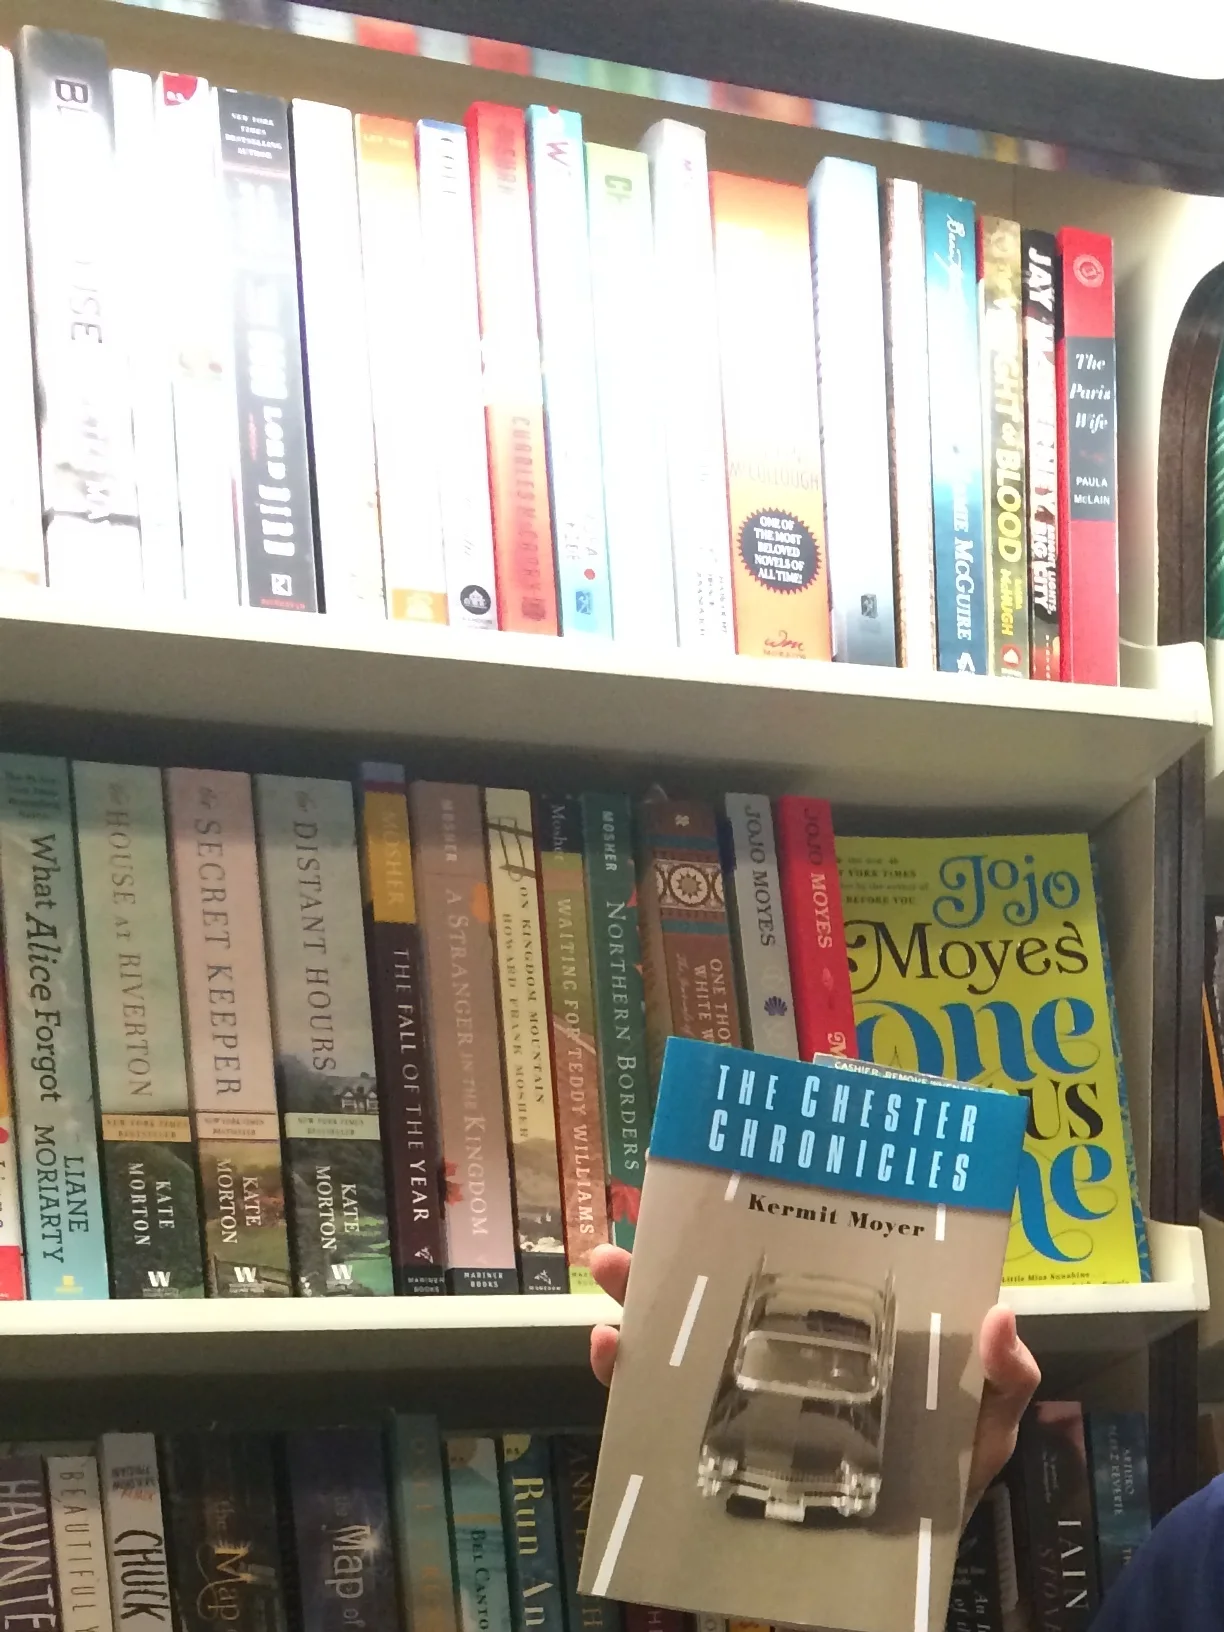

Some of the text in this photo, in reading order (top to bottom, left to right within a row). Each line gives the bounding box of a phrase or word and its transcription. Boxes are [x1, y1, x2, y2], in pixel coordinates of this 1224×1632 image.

[1069, 383, 1111, 401] Paris
[1075, 353, 1106, 371] The
[1075, 412, 1109, 433] Wife
[1076, 477, 1108, 487] PAULA
[754, 527, 802, 545] THE MOST
[756, 543, 801, 558] BELOVED
[759, 516, 795, 530] ONE OF
[754, 554, 805, 573] NOVELS OF
[757, 567, 776, 580] ALL
[954, 537, 975, 640] McGUIRE
[28, 833, 57, 909] What
[602, 810, 617, 873] MOSHER
[744, 805, 776, 948] JOJO MOYES
[193, 817, 232, 950] SECRET
[932, 854, 1081, 930] Jojo
[25, 911, 54, 1001] Alice
[846, 919, 1089, 995] Moyes
[32, 1009, 61, 1102] Forgot
[205, 963, 242, 1096] KEEPER
[556, 897, 595, 1236] WAITING FOR TEDDY WILLIAMS
[606, 900, 640, 1172] NORTHERN BORDERS
[392, 949, 430, 1223] THE FALL OF THE YEAR
[717, 1065, 978, 1144] THE CHESTER
[708, 1109, 970, 1192] CHRONICLES
[34, 1124, 64, 1264] MORIARTY
[63, 1154, 89, 1233] LIANE
[128, 1161, 151, 1247] MORTON
[155, 1179, 176, 1230] KATE
[216, 1157, 238, 1245] MORTON
[242, 1175, 262, 1228] KATE
[315, 1164, 338, 1251] MORTON
[339, 1182, 361, 1233] KATE
[748, 1193, 926, 1238] Kermit Moyer
[462, 1271, 504, 1280] MARINER
[469, 1281, 499, 1289] BOOKS
[58, 1471, 96, 1612] BEAUTIFUL
[512, 1476, 545, 1557] Run
[112, 1529, 169, 1621] CHUCK
